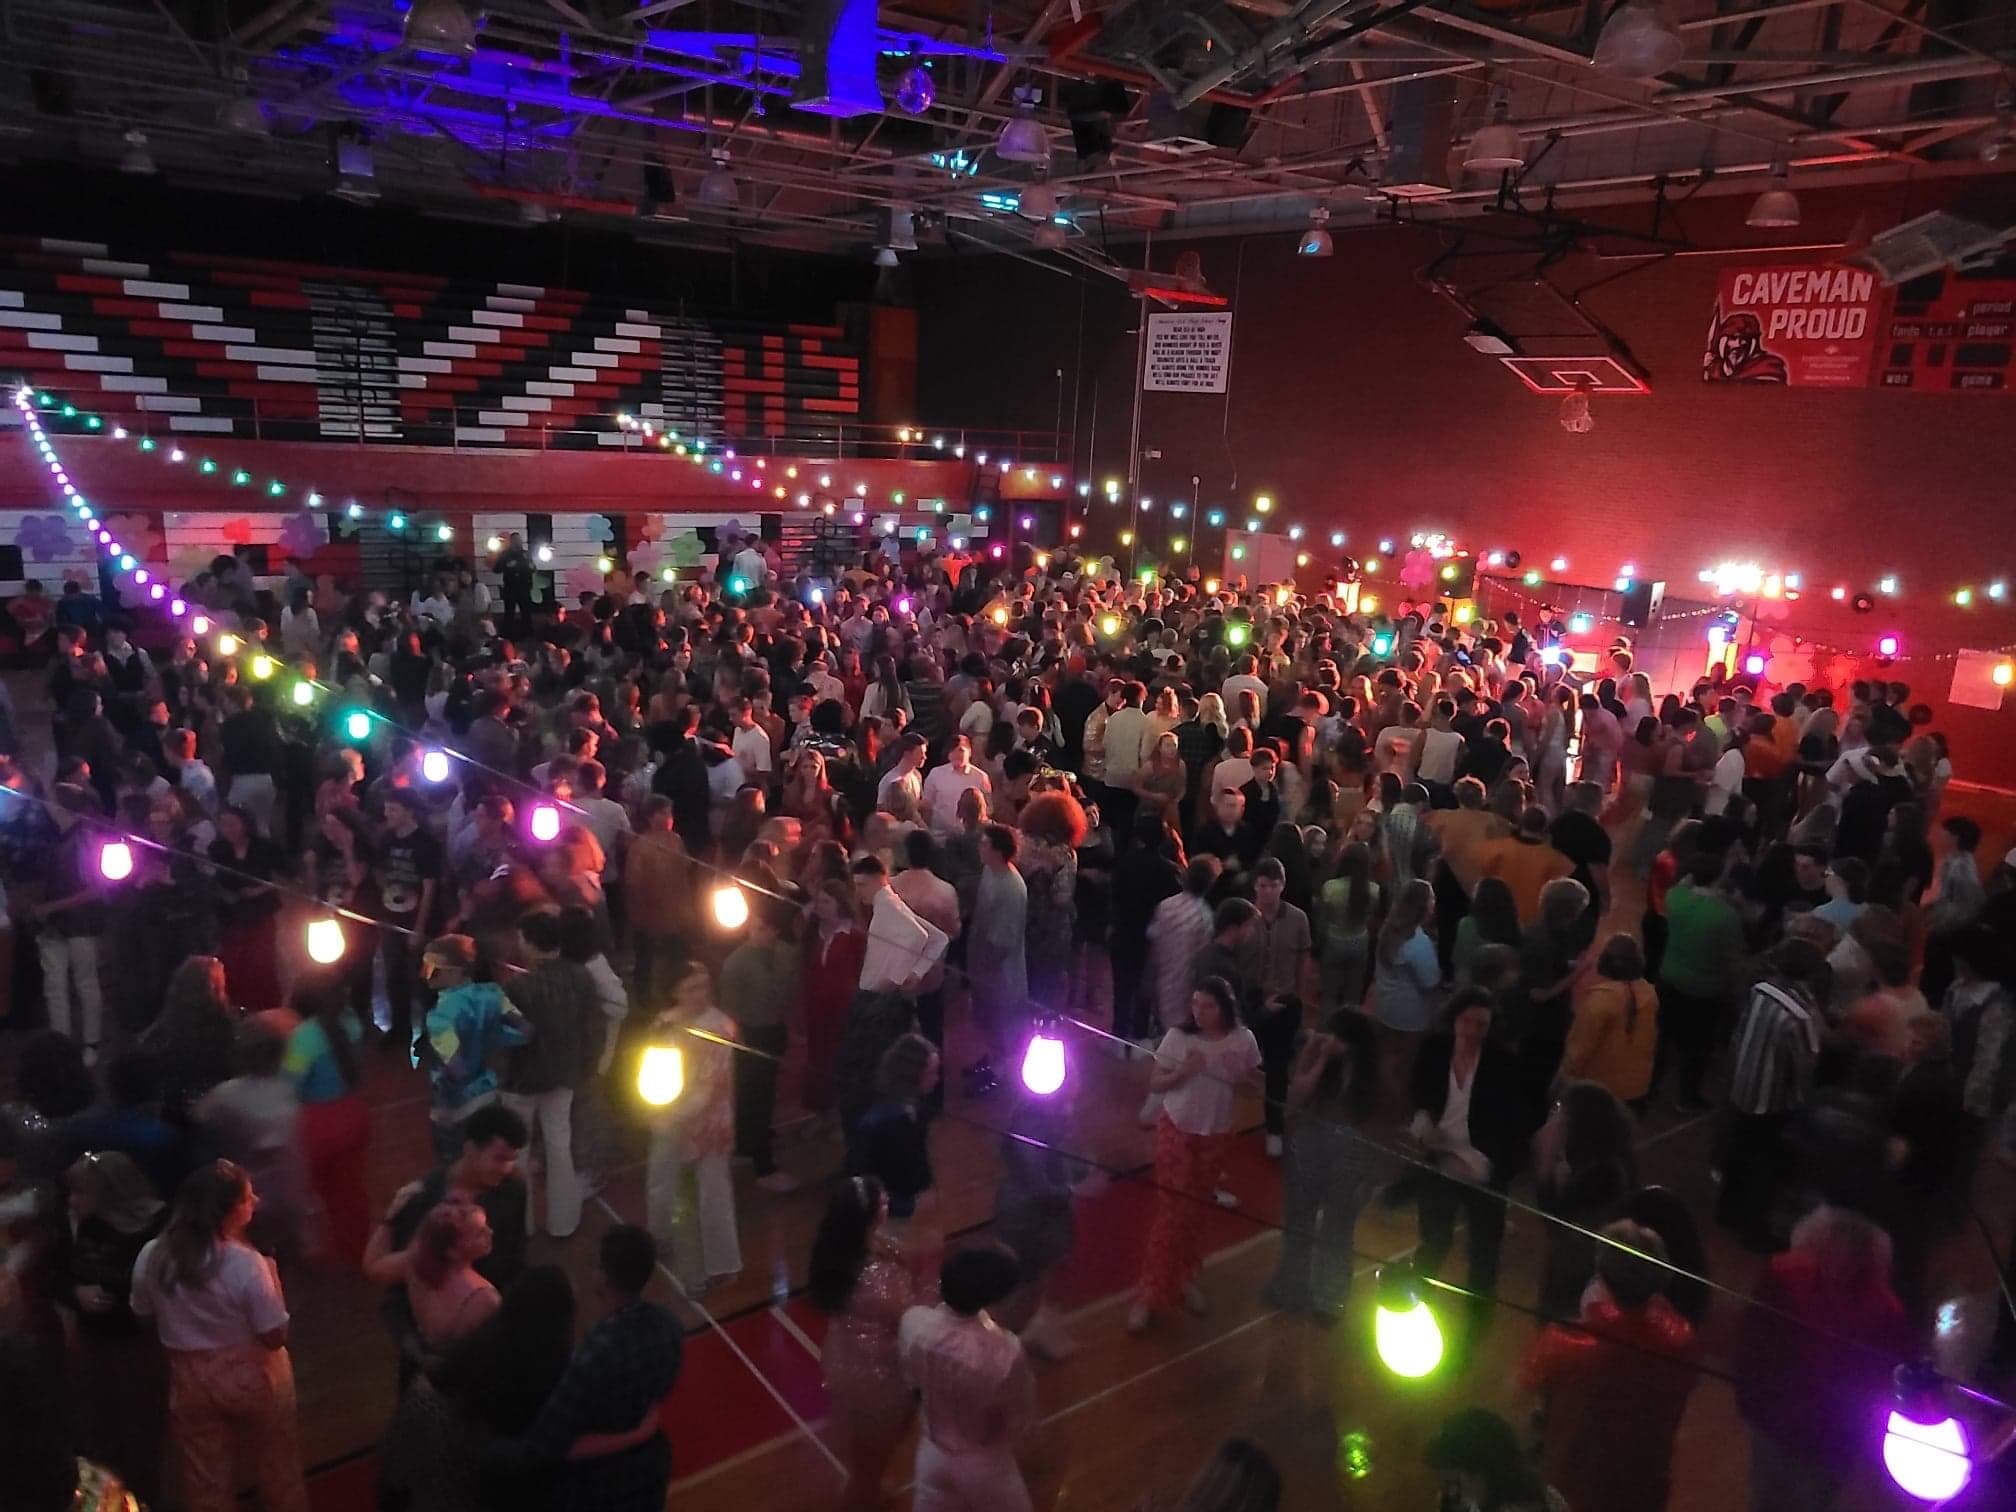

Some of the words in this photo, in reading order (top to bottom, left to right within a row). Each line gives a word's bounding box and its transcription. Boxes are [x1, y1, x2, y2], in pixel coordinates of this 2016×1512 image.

[1732, 270, 1873, 305] CAVEMAN
[1768, 308, 1867, 339] PROUD
[1967, 323, 2008, 338] player
